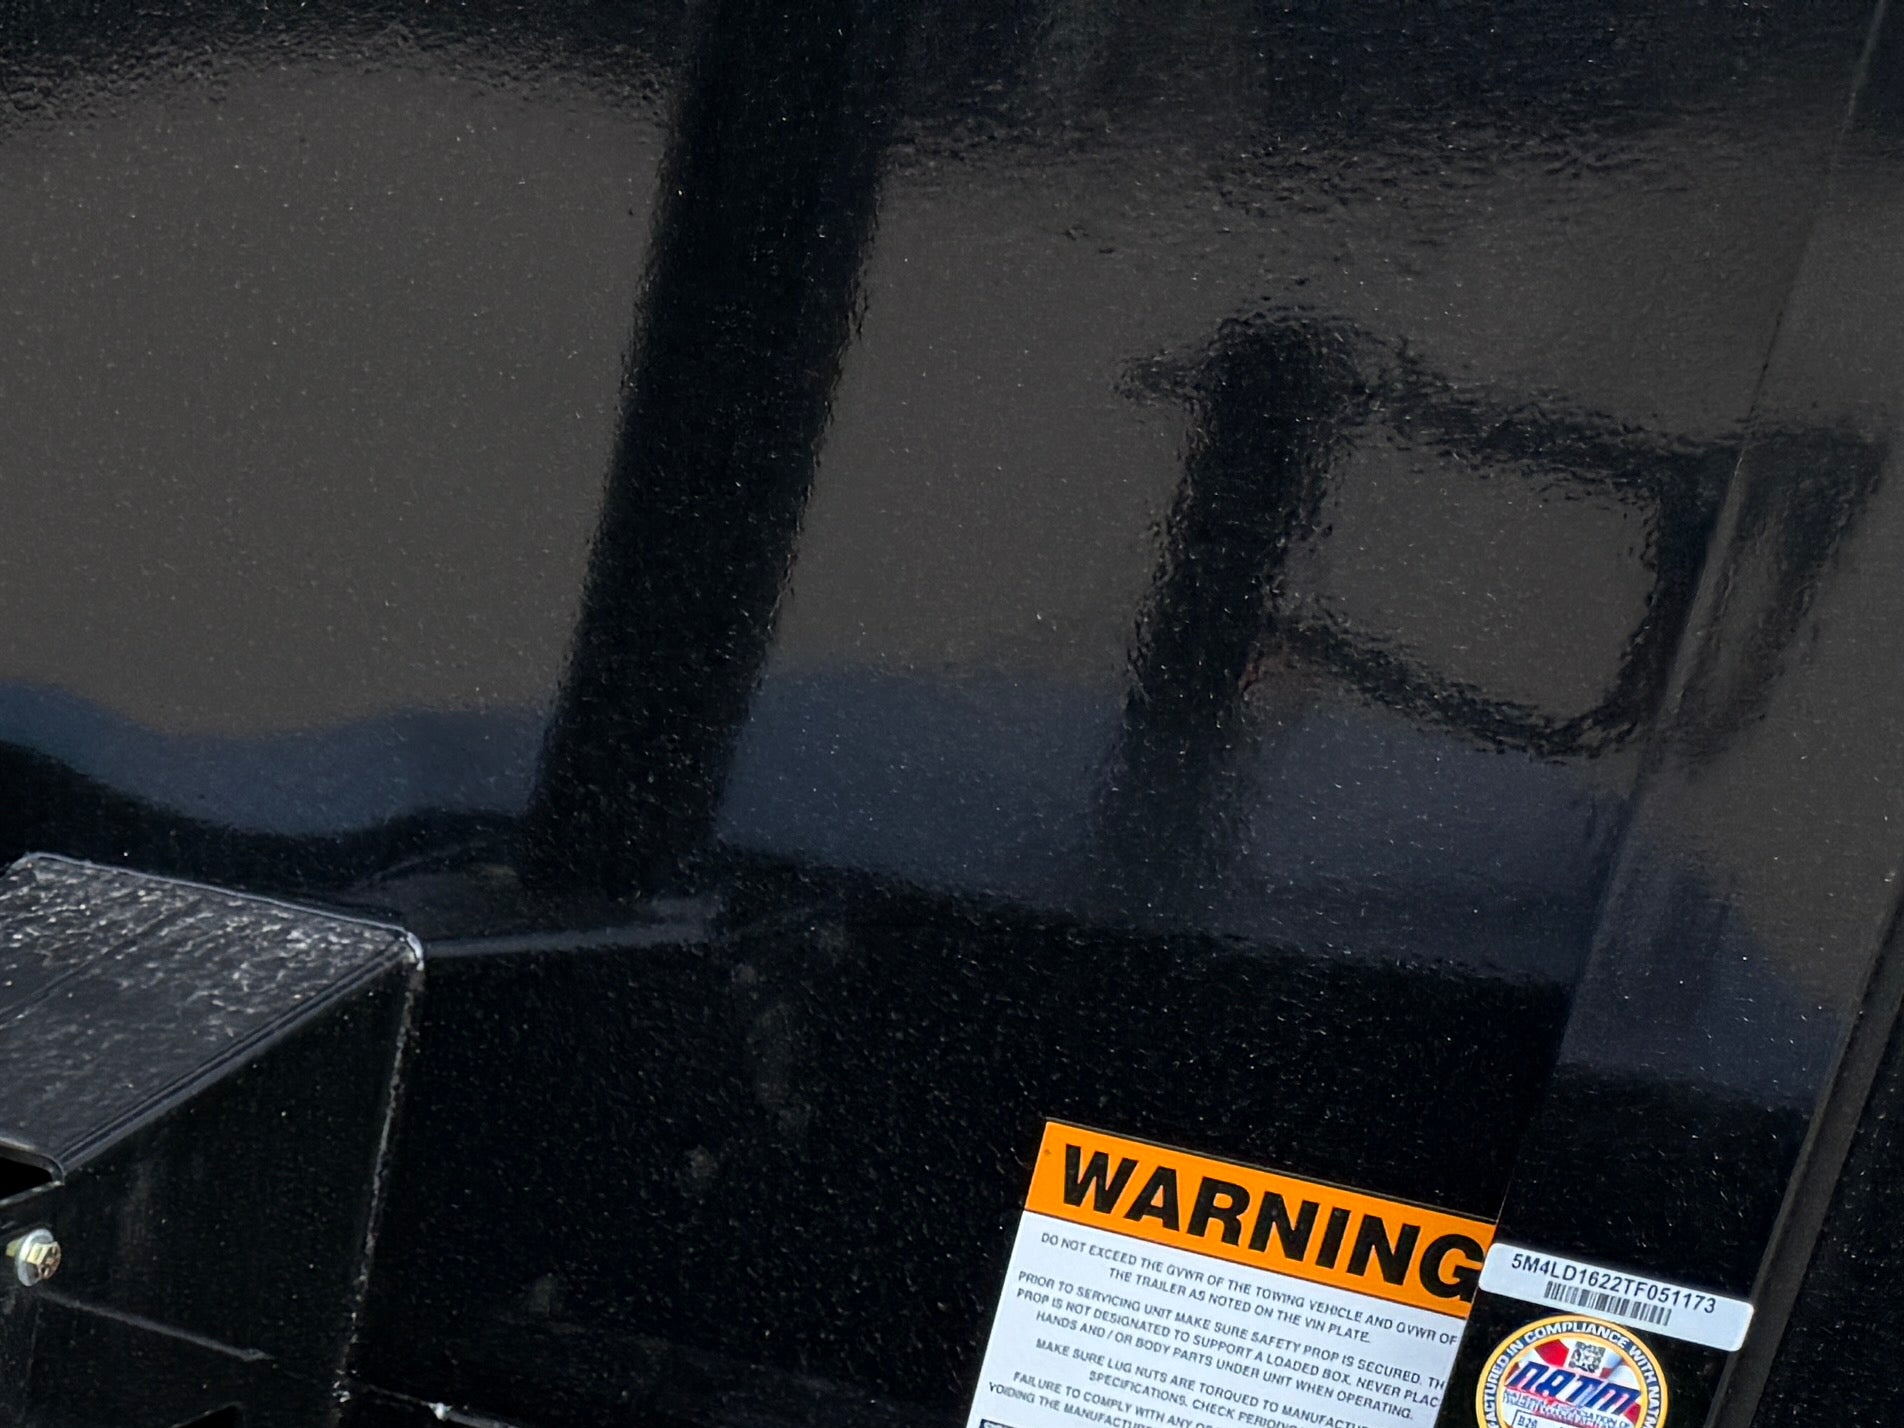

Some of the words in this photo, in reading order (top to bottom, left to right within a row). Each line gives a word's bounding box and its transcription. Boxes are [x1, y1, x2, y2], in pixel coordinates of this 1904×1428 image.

[1062, 1144, 1490, 1302] WARNING
[1040, 1231, 1059, 1246] DO
[1060, 1237, 1087, 1252] NOT
[1087, 1244, 1137, 1265] EXCEED
[1140, 1256, 1163, 1273] THE
[1165, 1263, 1204, 1282] GVWR
[1206, 1273, 1225, 1287] OF
[1227, 1278, 1252, 1295] THE
[1255, 1285, 1305, 1308] TOWING
[1308, 1299, 1363, 1323] VEHICLE
[1363, 1313, 1393, 1330] AND
[1395, 1320, 1437, 1341] GVWR
[1438, 1331, 1458, 1345] OF
[1109, 1266, 1132, 1282] THE
[1135, 1273, 1187, 1296] TRAILER
[1187, 1287, 1206, 1302] AS
[1207, 1292, 1251, 1313] NOTED
[1253, 1303, 1274, 1318] ON
[1276, 1308, 1302, 1326] THE
[1304, 1316, 1326, 1332] VIN
[1510, 1252, 1717, 1314] 5M4LD1622TF051173
[1016, 1287, 1049, 1304] PROP
[1050, 1296, 1063, 1309] IS
[1064, 1300, 1092, 1316] NOT
[1092, 1307, 1171, 1337] DESIGNATED
[1173, 1328, 1190, 1343] TO
[1192, 1333, 1253, 1359] SUPPORT
[1253, 1350, 1263, 1362] A
[1265, 1352, 1319, 1376] LOADED
[1355, 1375, 1401, 1398] NEVER
[1017, 1269, 1055, 1289] PRIOR
[1057, 1280, 1074, 1294] TO
[1075, 1285, 1141, 1312] SERVICING
[1143, 1303, 1173, 1319] UNIT
[1173, 1311, 1211, 1330] MAKE
[1213, 1320, 1249, 1340] SURE
[1249, 1330, 1301, 1353] SAFETY
[1301, 1344, 1340, 1362] PROP
[1340, 1354, 1355, 1367] IS
[1356, 1357, 1422, 1386] SECURED.
[1506, 1340, 1524, 1356] IN
[1525, 1321, 1631, 1349] COMPLIANCE
[1629, 1346, 1657, 1382] WITH
[1012, 1370, 1062, 1394] FAILURE
[1065, 1385, 1081, 1399] TO
[1082, 1390, 1132, 1413] COMPLY
[1134, 1405, 1165, 1423] WITH
[1035, 1309, 1078, 1330] HANDS
[1078, 1322, 1106, 1338] AND
[1113, 1330, 1133, 1345] OR
[1134, 1336, 1171, 1354] BODY
[1171, 1346, 1213, 1367] PARTS
[1215, 1357, 1260, 1379] UNDER
[1261, 1370, 1293, 1387] UNIT
[1295, 1378, 1334, 1398] WHEN
[1335, 1389, 1413, 1420] OPERATING.
[1035, 1337, 1070, 1357] MAKE
[1071, 1347, 1105, 1366] SURE
[1106, 1357, 1132, 1373] LUG
[1134, 1365, 1168, 1383] NUTS
[1169, 1374, 1196, 1391] ARE
[1199, 1381, 1259, 1407] TORQUED
[1262, 1398, 1279, 1413] TO
[1038, 1394, 1060, 1411] THE
[1191, 1397, 1236, 1420] CHECK
